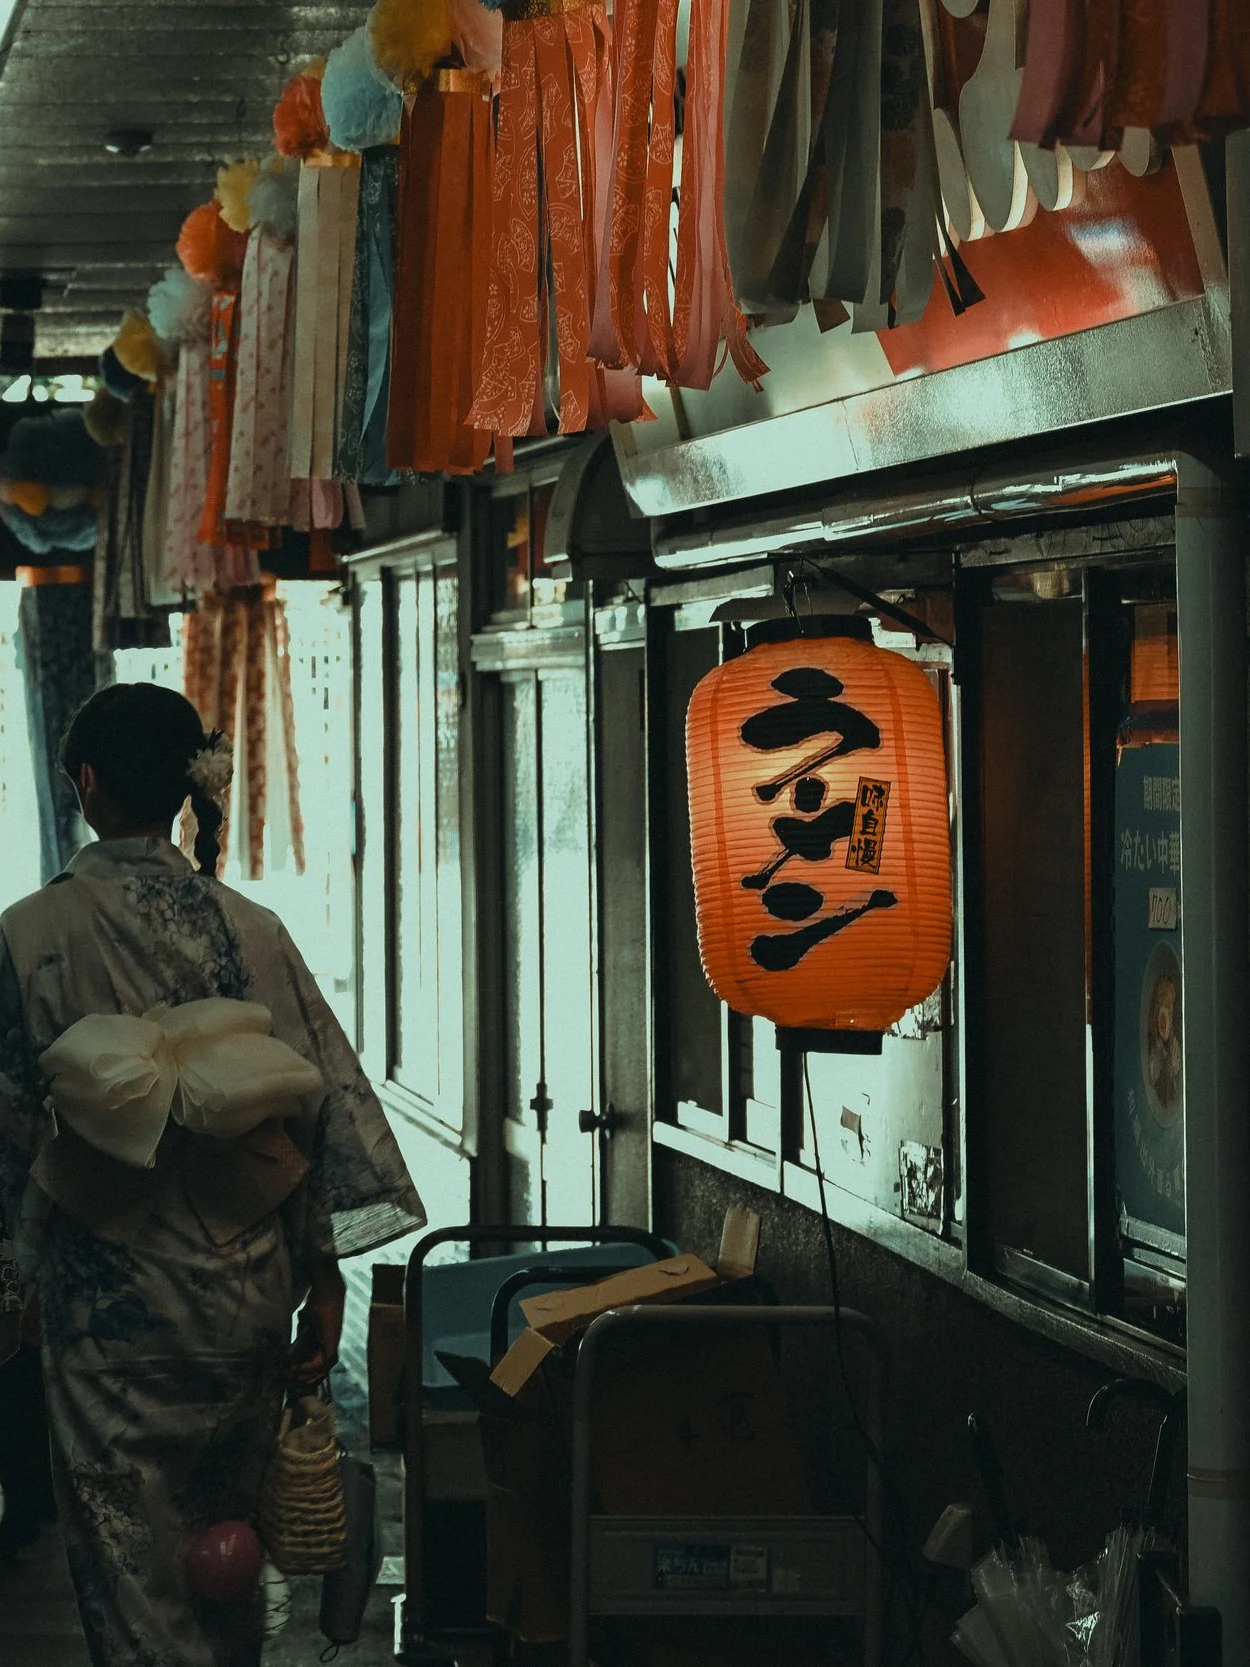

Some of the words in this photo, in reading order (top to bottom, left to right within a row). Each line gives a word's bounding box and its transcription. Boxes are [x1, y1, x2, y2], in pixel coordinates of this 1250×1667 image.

[739, 666, 900, 973] ラーメン
[850, 783, 886, 868] 味自慢
